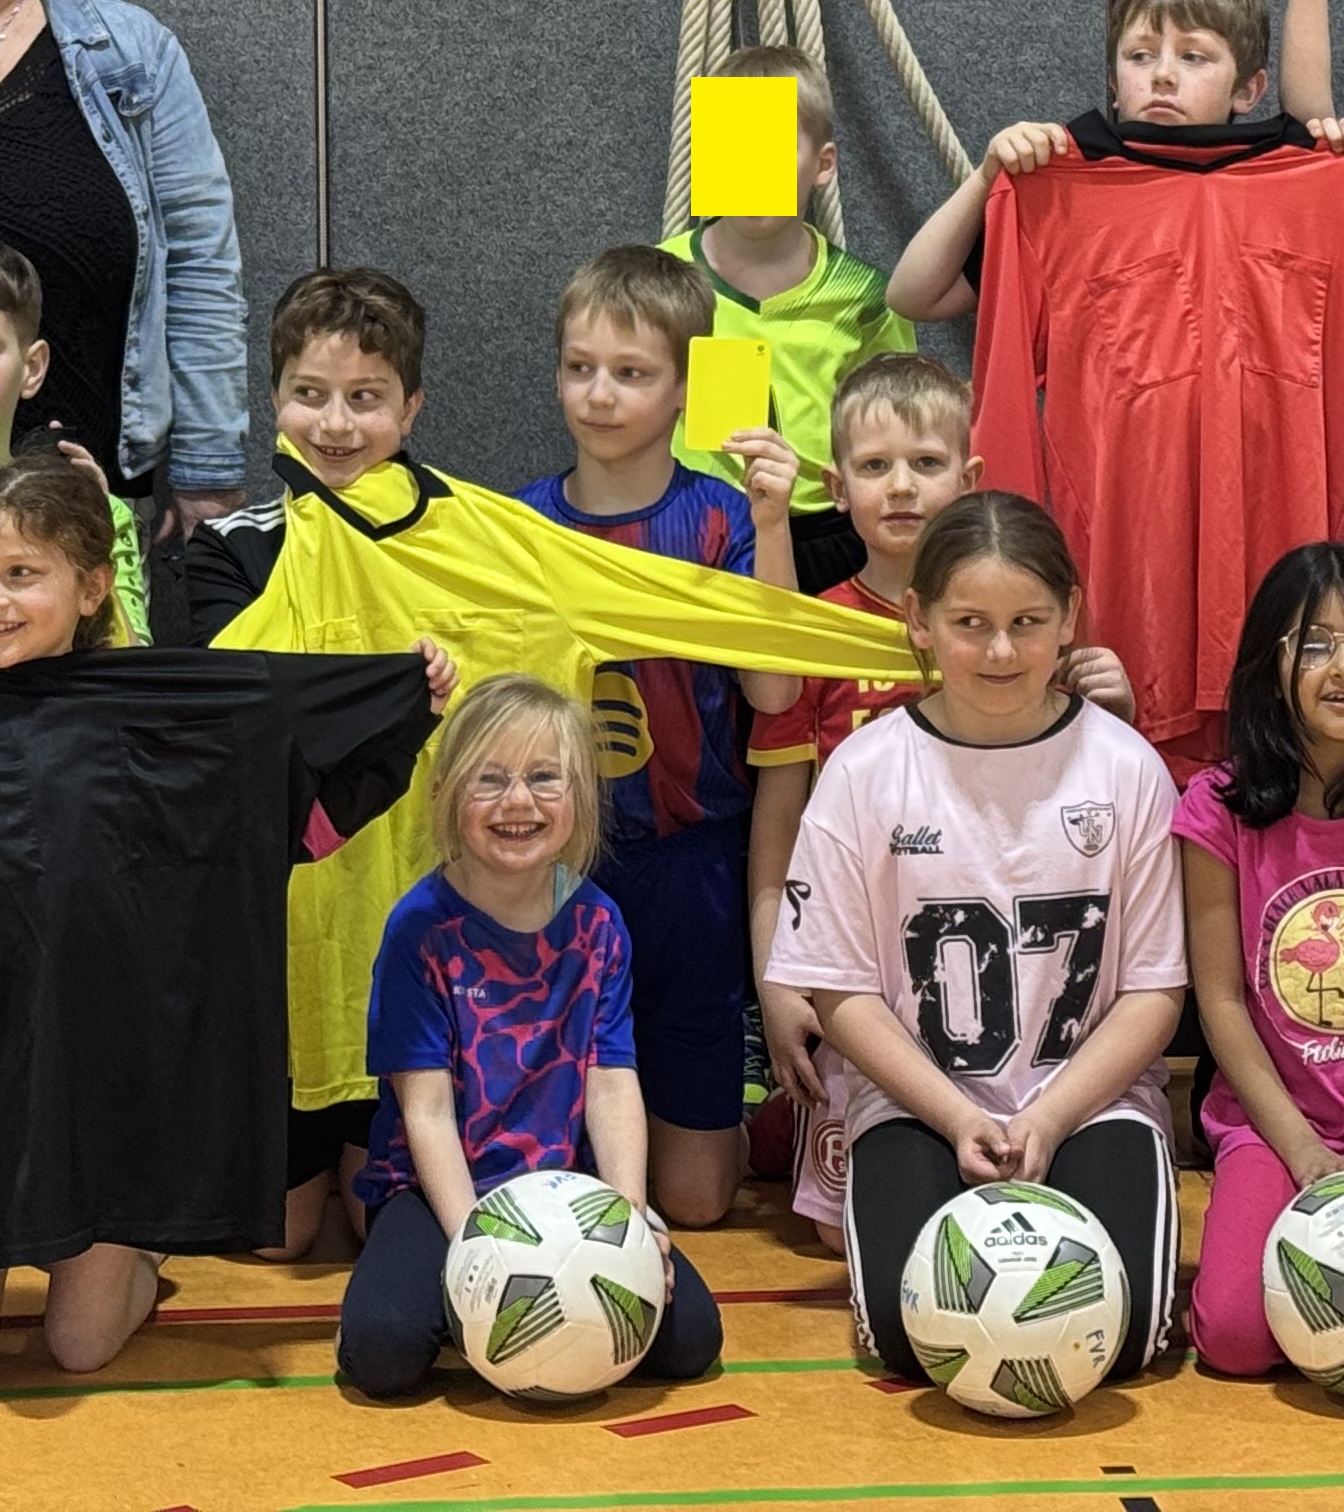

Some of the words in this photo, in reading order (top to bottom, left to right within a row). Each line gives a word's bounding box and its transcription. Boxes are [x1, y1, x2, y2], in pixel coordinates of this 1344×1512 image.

[900, 889, 1111, 1077] 07
[984, 1232, 1048, 1248] adidas
[1085, 1329, 1106, 1369] FVR
